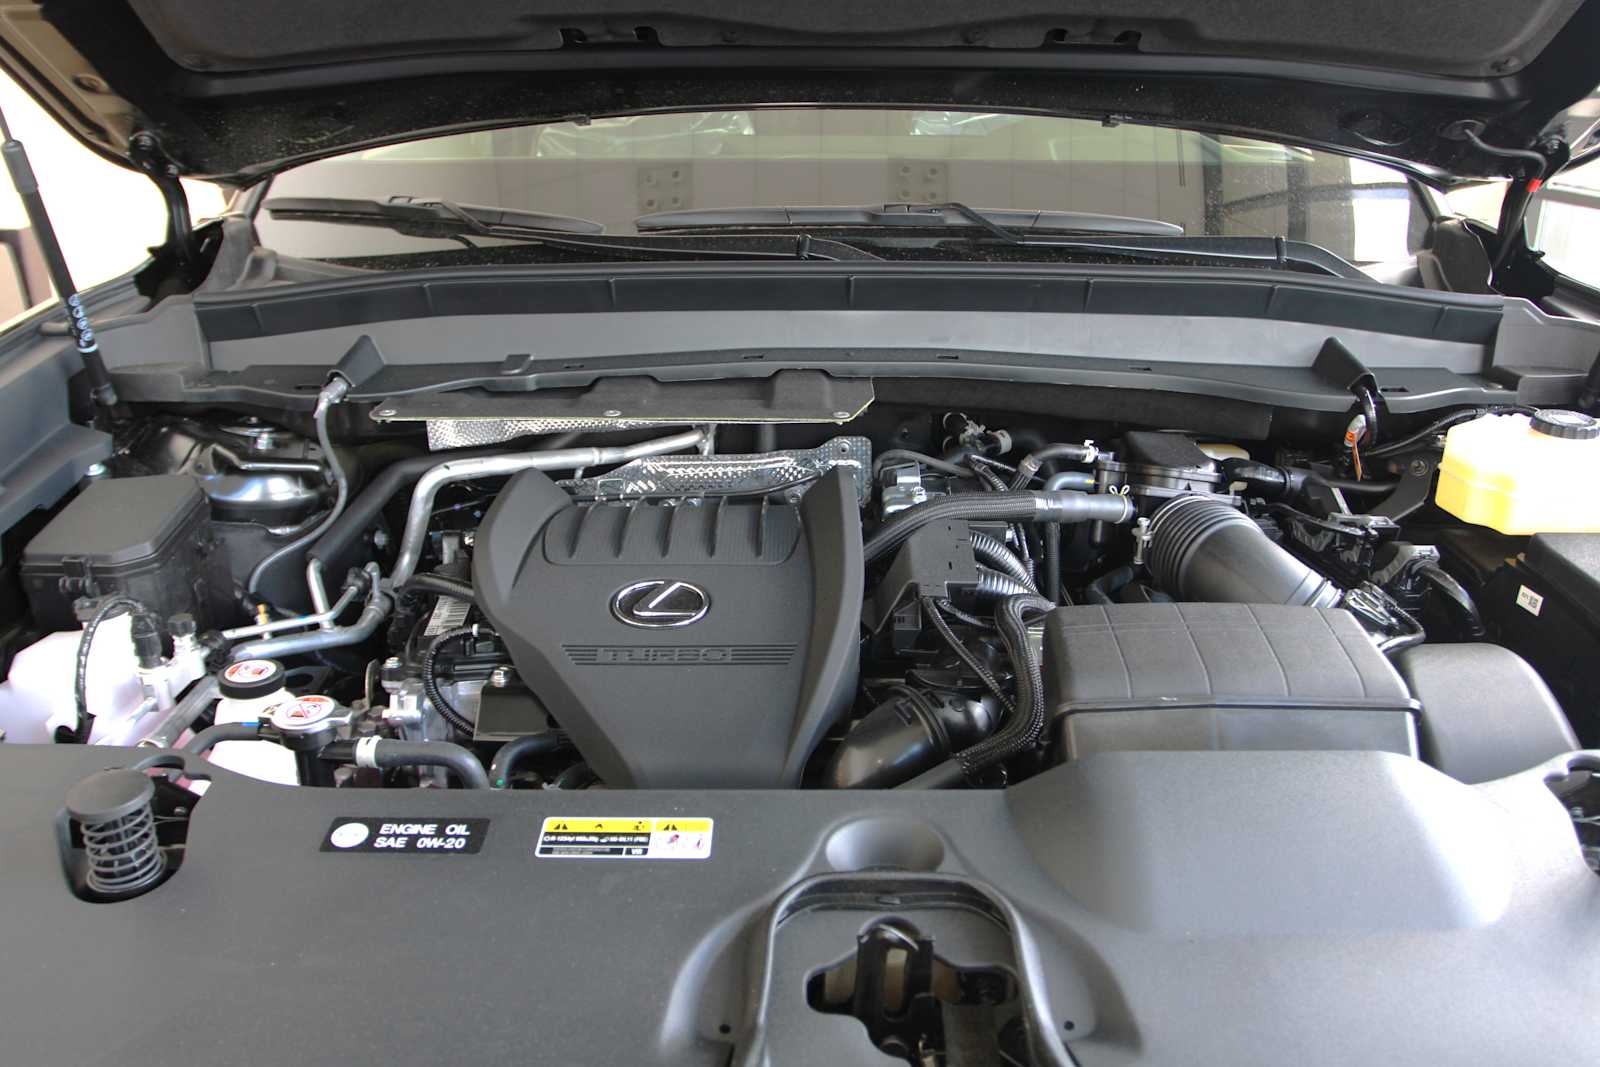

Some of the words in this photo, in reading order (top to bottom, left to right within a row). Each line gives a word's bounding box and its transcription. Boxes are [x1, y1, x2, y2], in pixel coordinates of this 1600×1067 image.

[601, 648, 729, 662] TURBO
[380, 823, 438, 835] ENGINE
[445, 824, 470, 835] OIL
[374, 837, 408, 848] SAE
[416, 837, 466, 849] 0W-20
